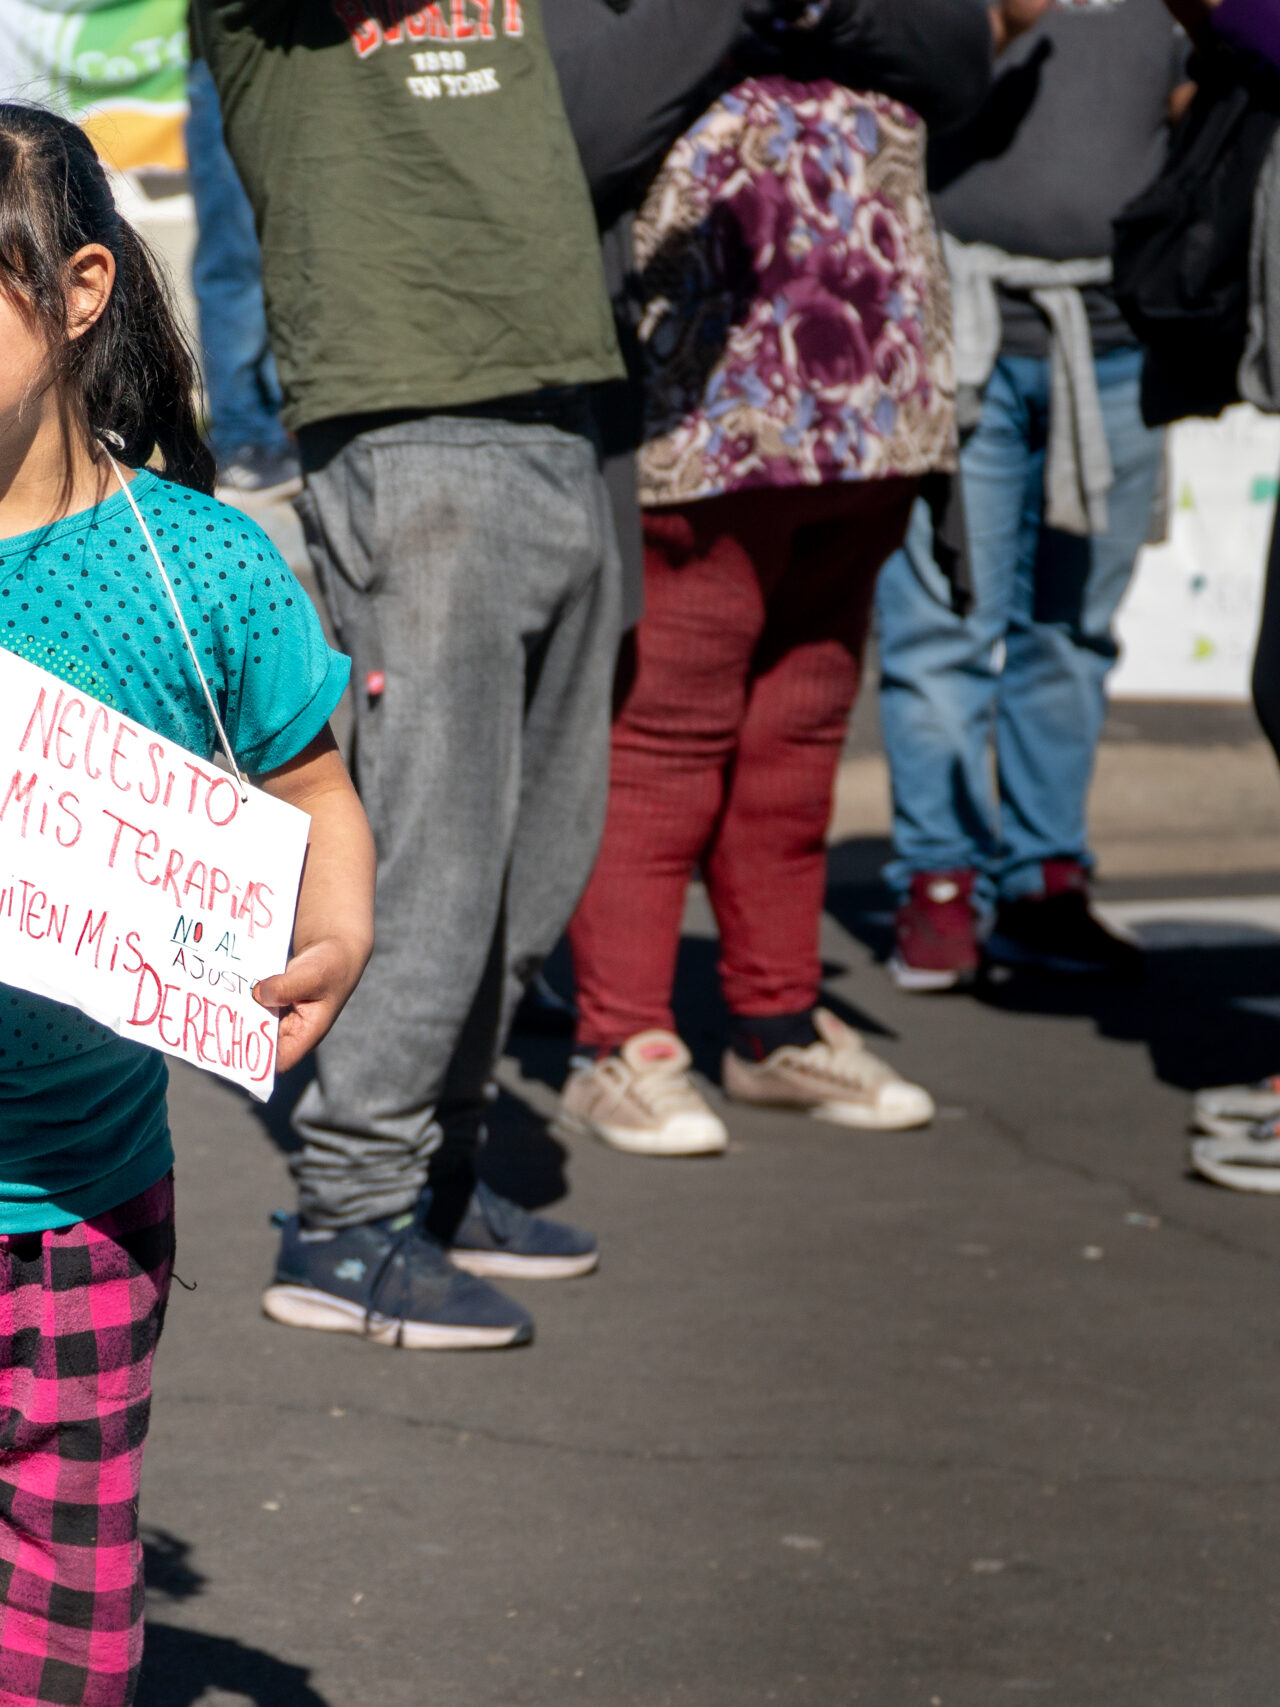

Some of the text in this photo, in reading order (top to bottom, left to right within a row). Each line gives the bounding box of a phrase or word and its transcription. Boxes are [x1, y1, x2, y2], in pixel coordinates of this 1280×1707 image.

[440, 68, 501, 97] YORK
[18, 686, 240, 827] NECESITO
[172, 914, 241, 960] NO AL
[126, 963, 274, 1081] DERECHOS
